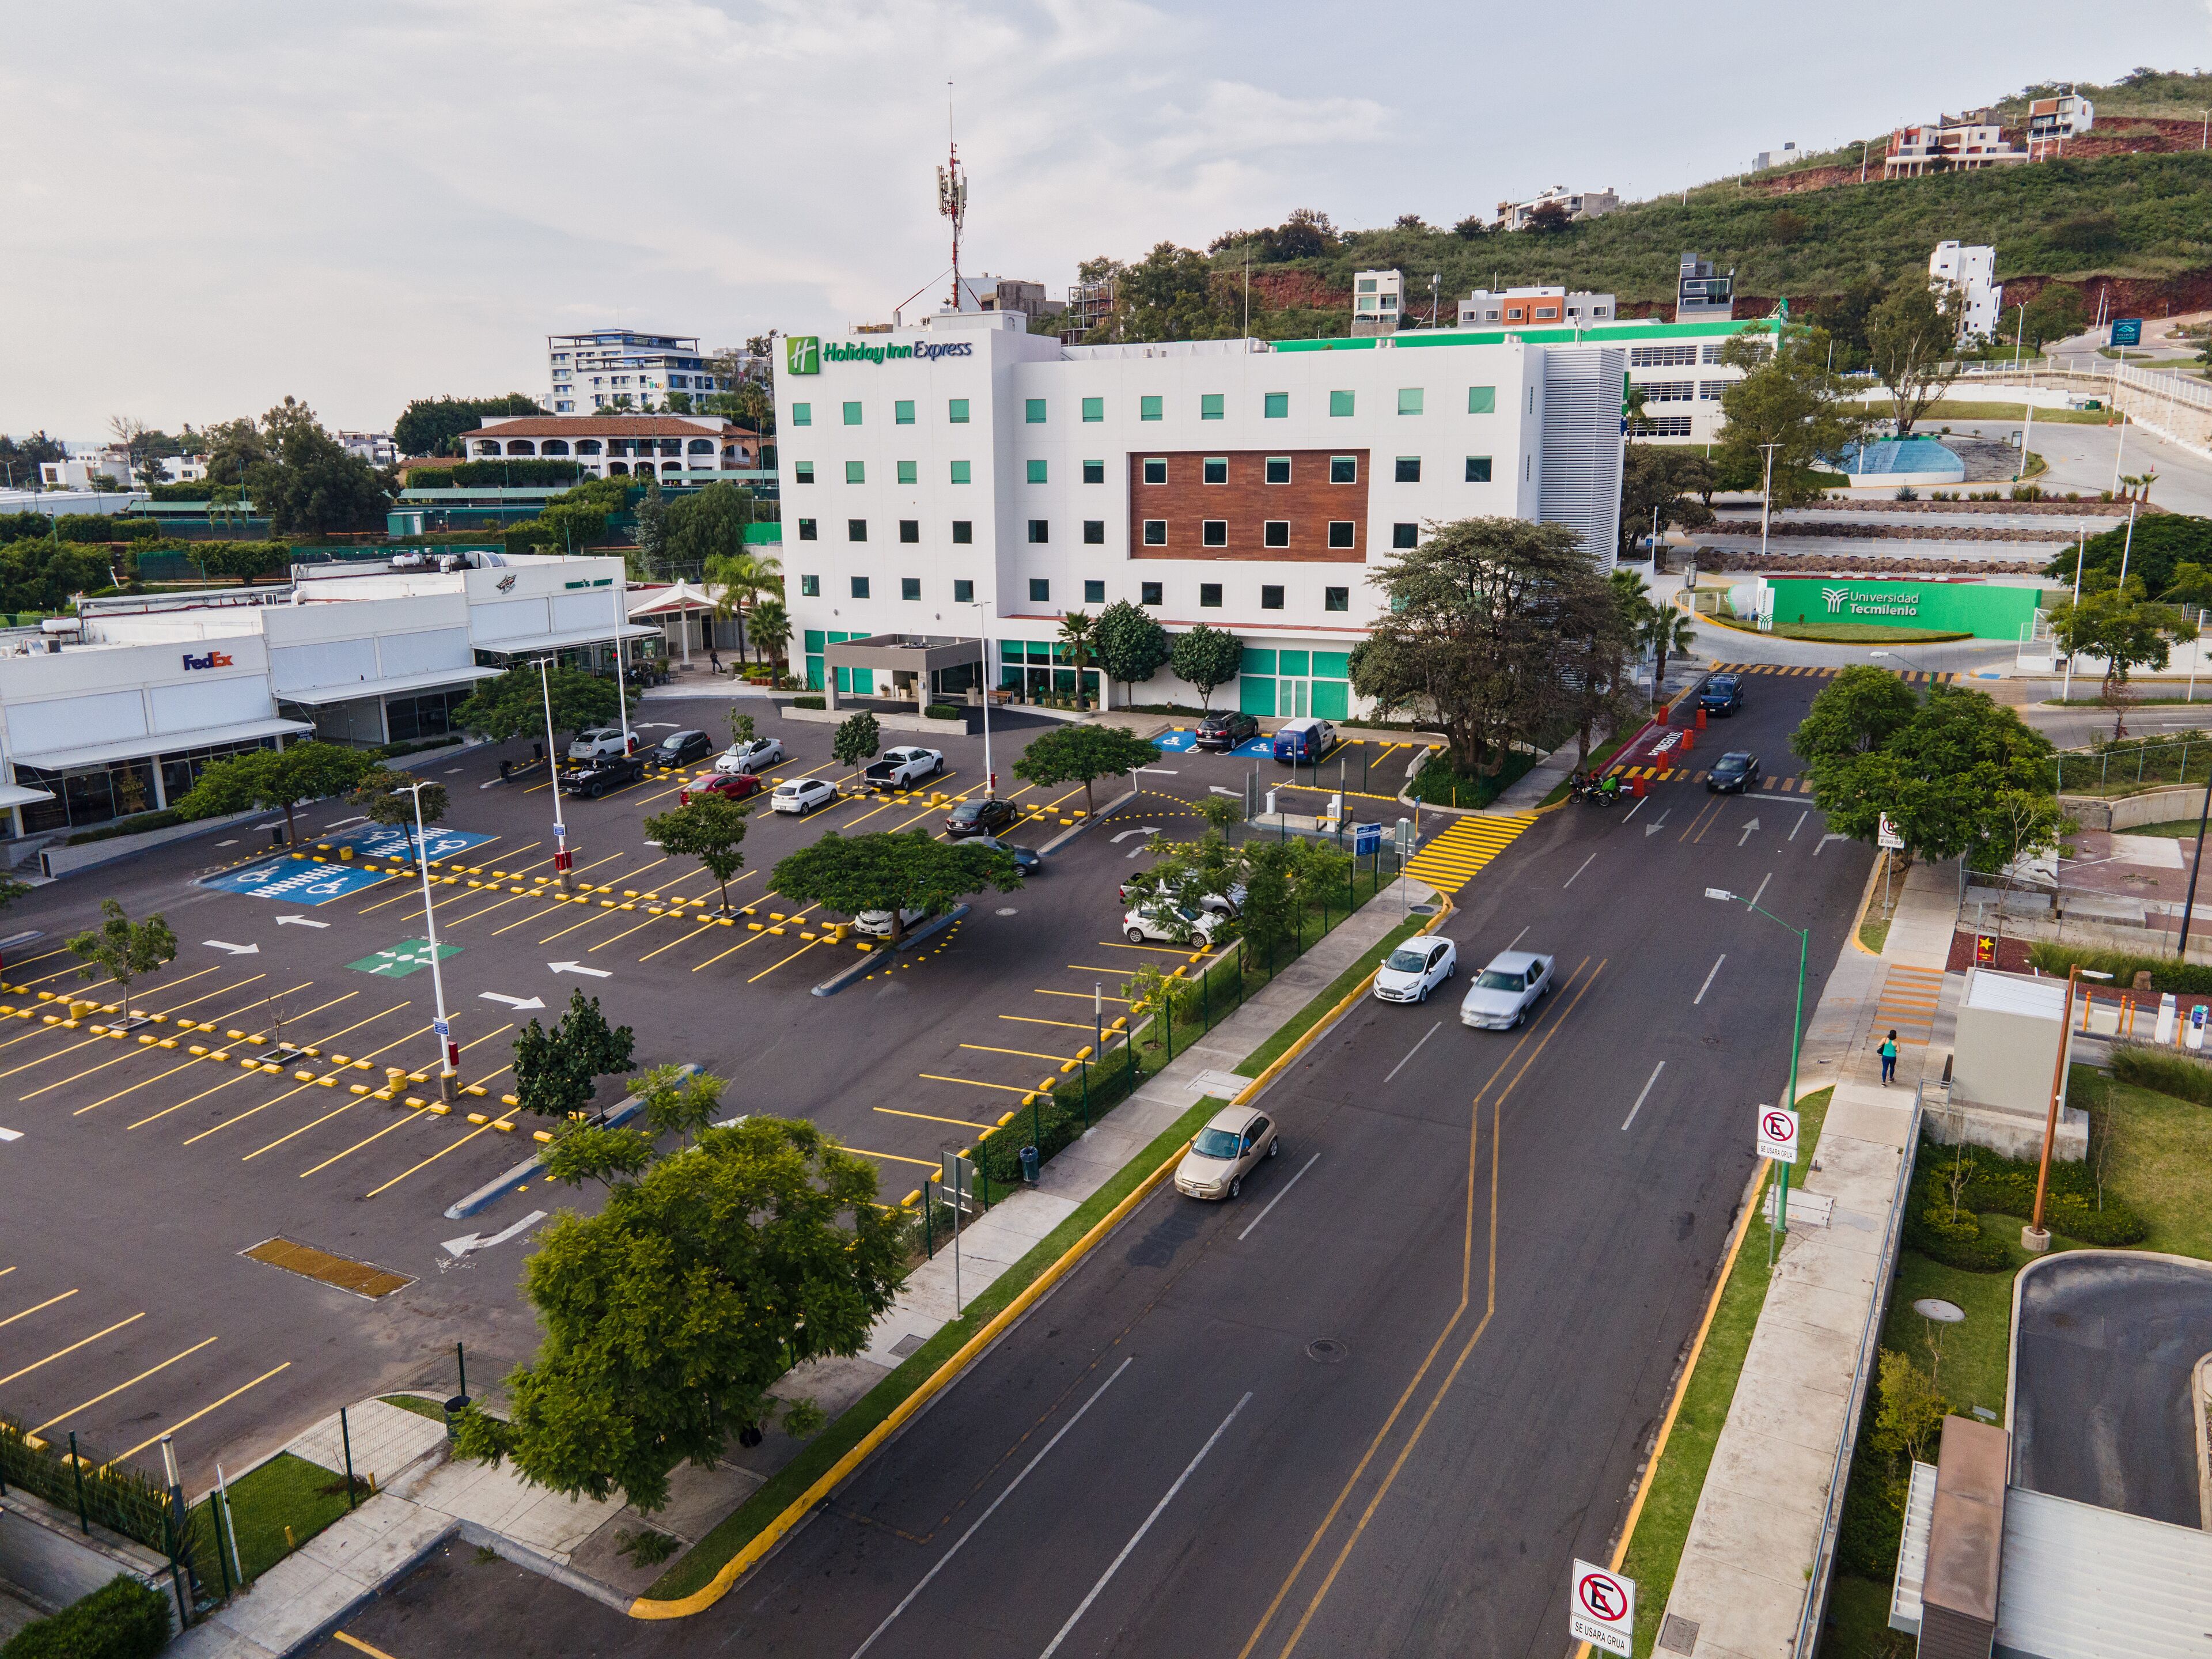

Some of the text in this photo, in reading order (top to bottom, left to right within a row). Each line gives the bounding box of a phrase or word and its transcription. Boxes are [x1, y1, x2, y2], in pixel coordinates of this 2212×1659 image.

[823, 340, 972, 365] Holiday Inn Express
[1850, 591, 1920, 604] Universidad
[1849, 603, 1918, 616] Tecmilenio
[183, 651, 234, 671] FedEx
[1767, 1146, 1780, 1156] USARA
[1781, 1150, 1793, 1158] GRUA
[1575, 1622, 1625, 1650] SE USARA GRUA
